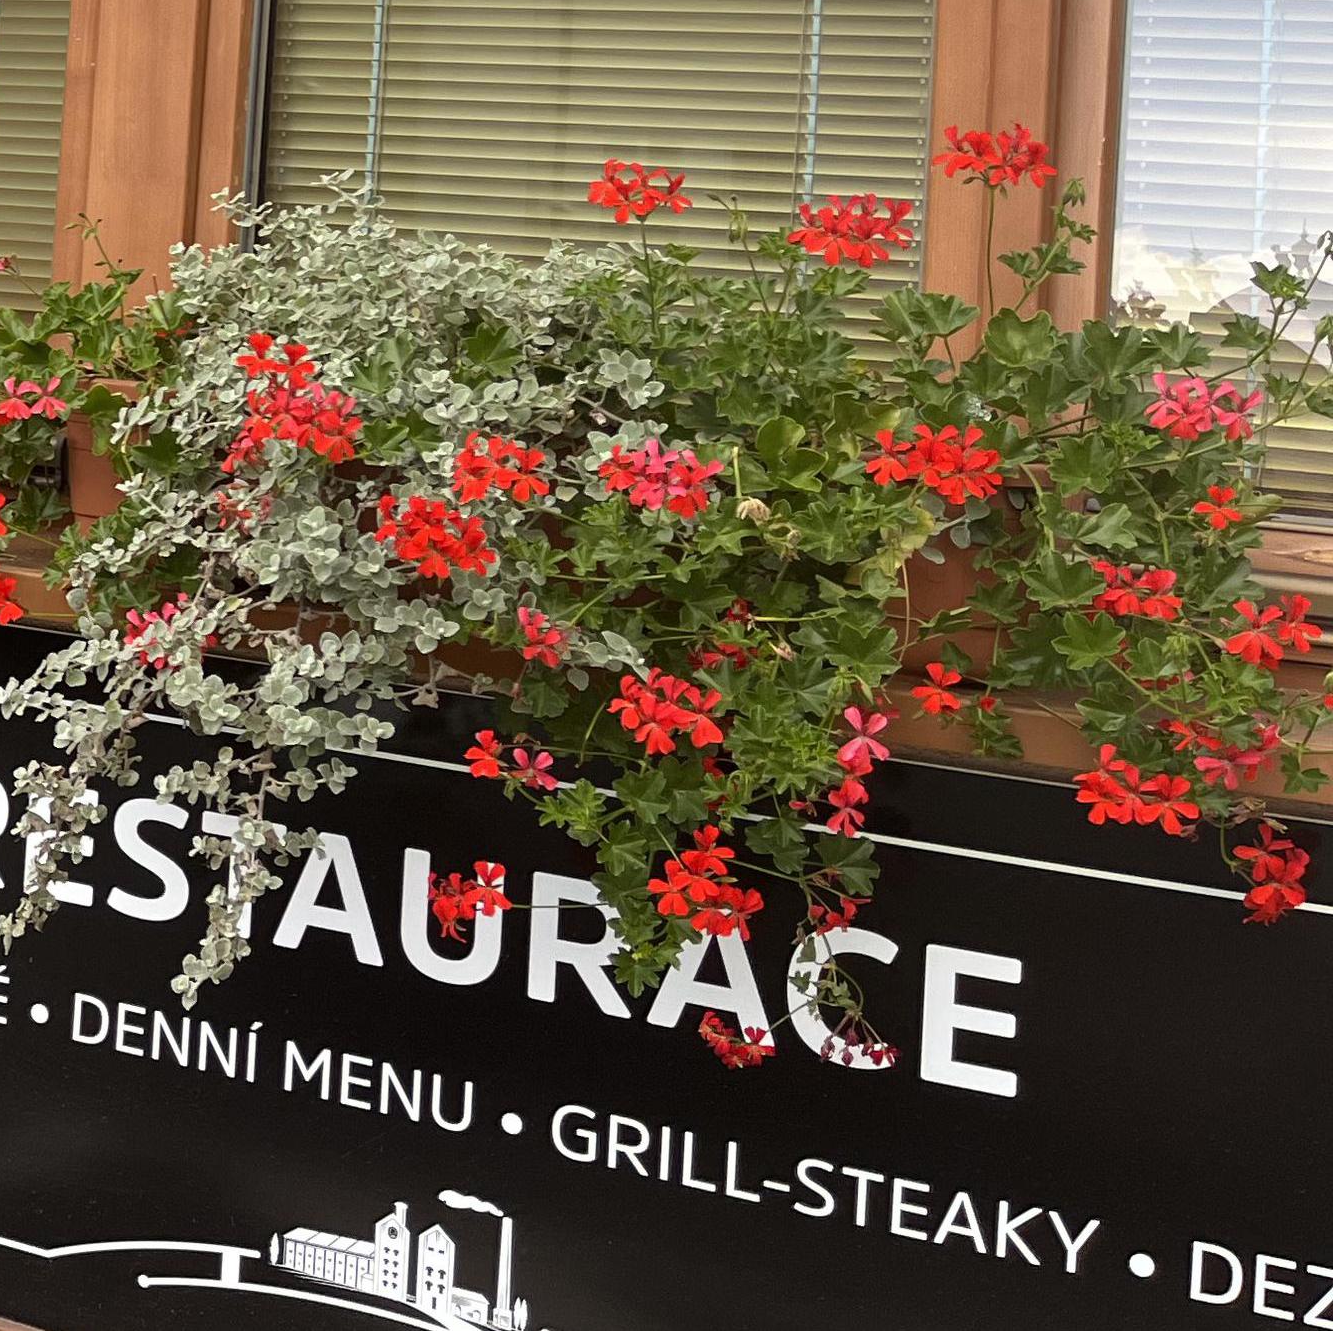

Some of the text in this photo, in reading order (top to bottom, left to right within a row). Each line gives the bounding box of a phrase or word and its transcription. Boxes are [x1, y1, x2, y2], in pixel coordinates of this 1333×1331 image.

[71, 992, 264, 1084] DENNÍ
[283, 1039, 475, 1133] MENU
[551, 1103, 1101, 1274] GRILL-STEAKY
